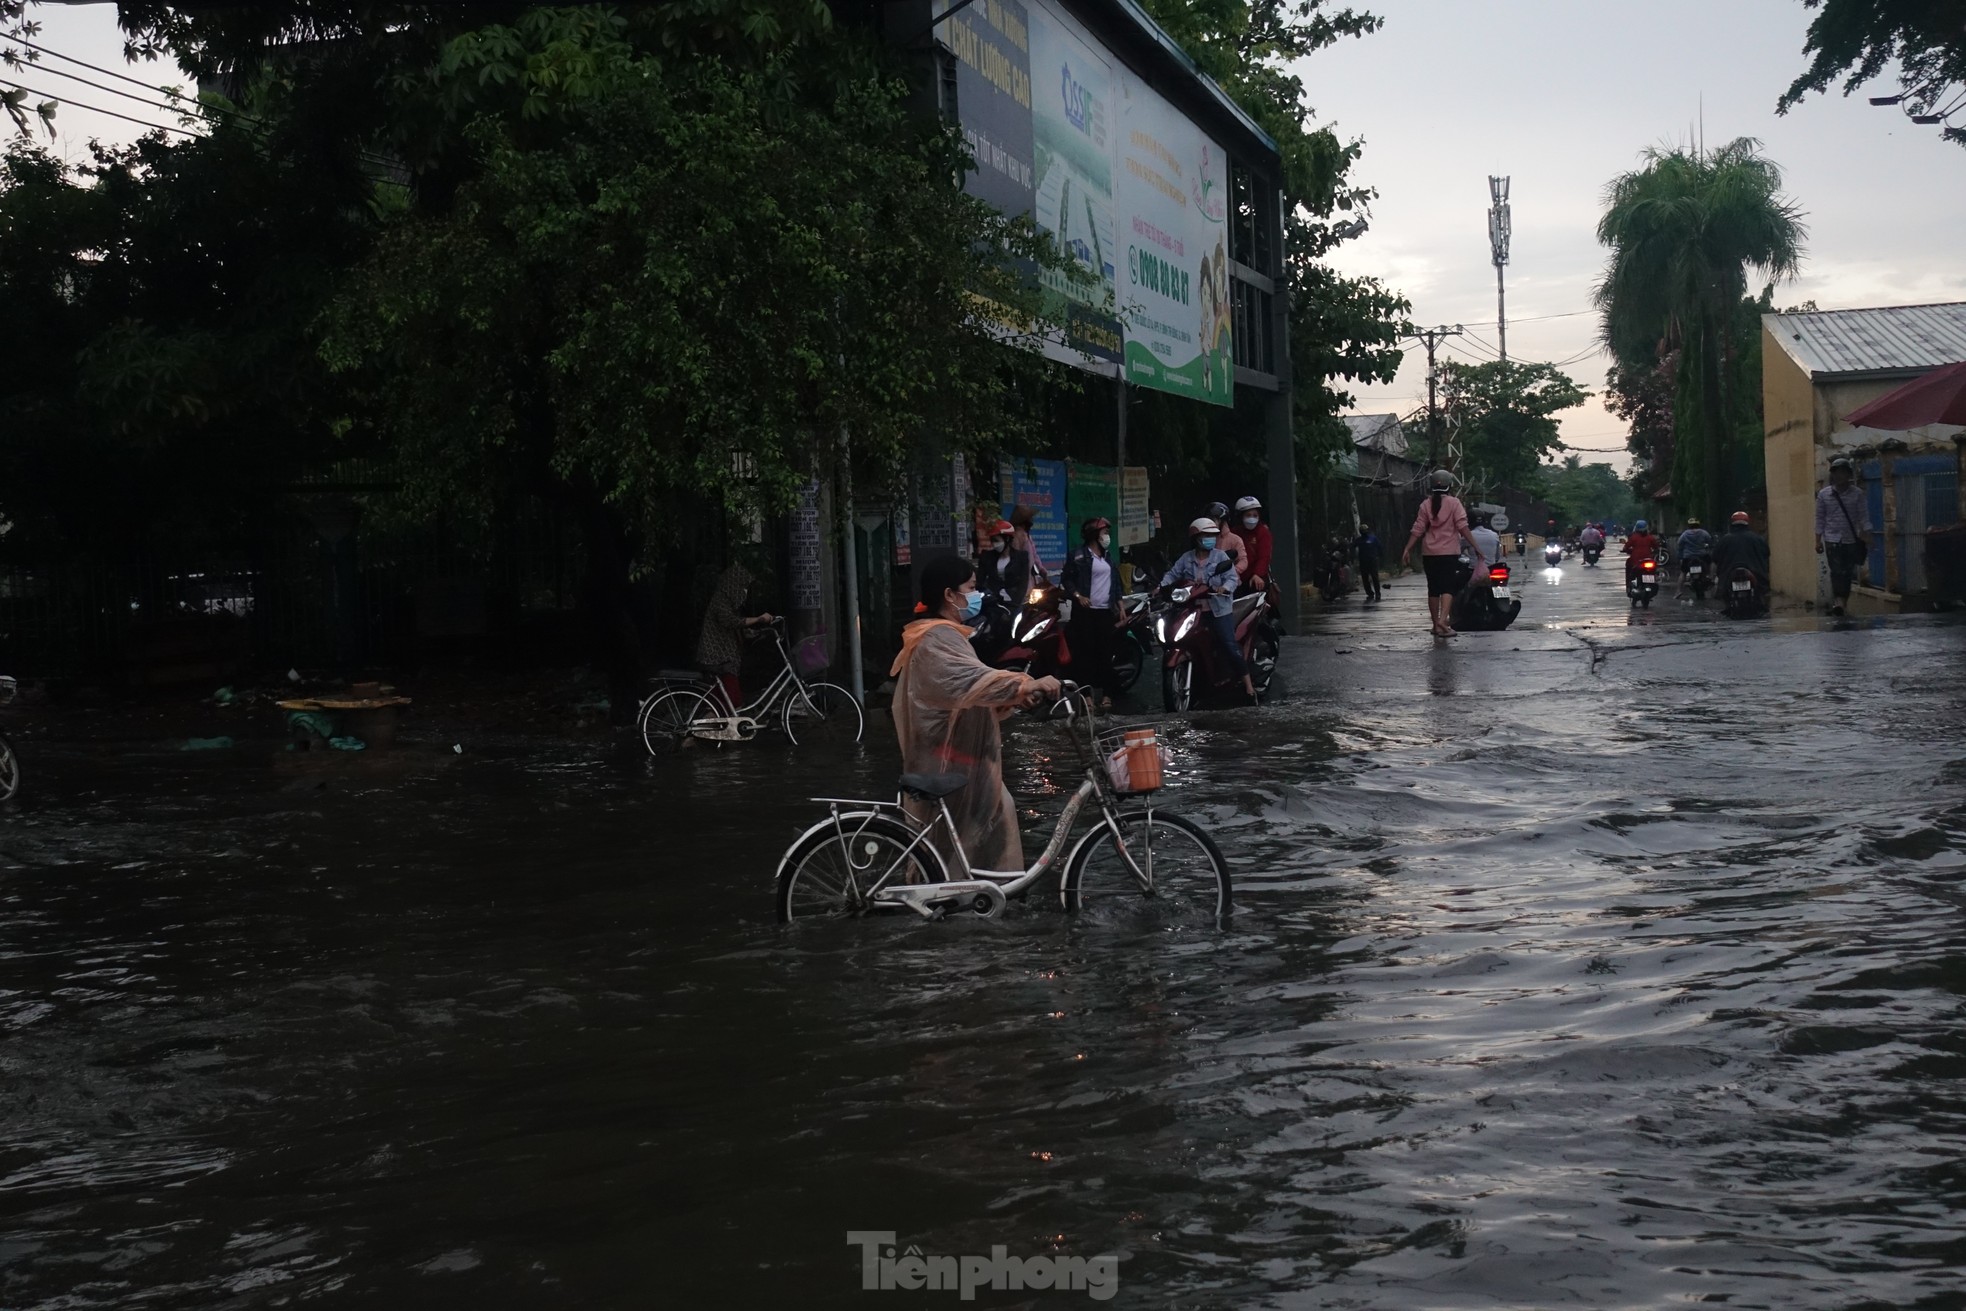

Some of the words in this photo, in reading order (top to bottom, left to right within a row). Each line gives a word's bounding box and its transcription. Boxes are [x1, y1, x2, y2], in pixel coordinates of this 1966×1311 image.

[952, 16, 978, 71] CHẤT
[980, 38, 1011, 96] LƯỢNG
[1012, 65, 1030, 109] CAO
[1139, 248, 1159, 293] 0908
[1171, 264, 1180, 302] 83
